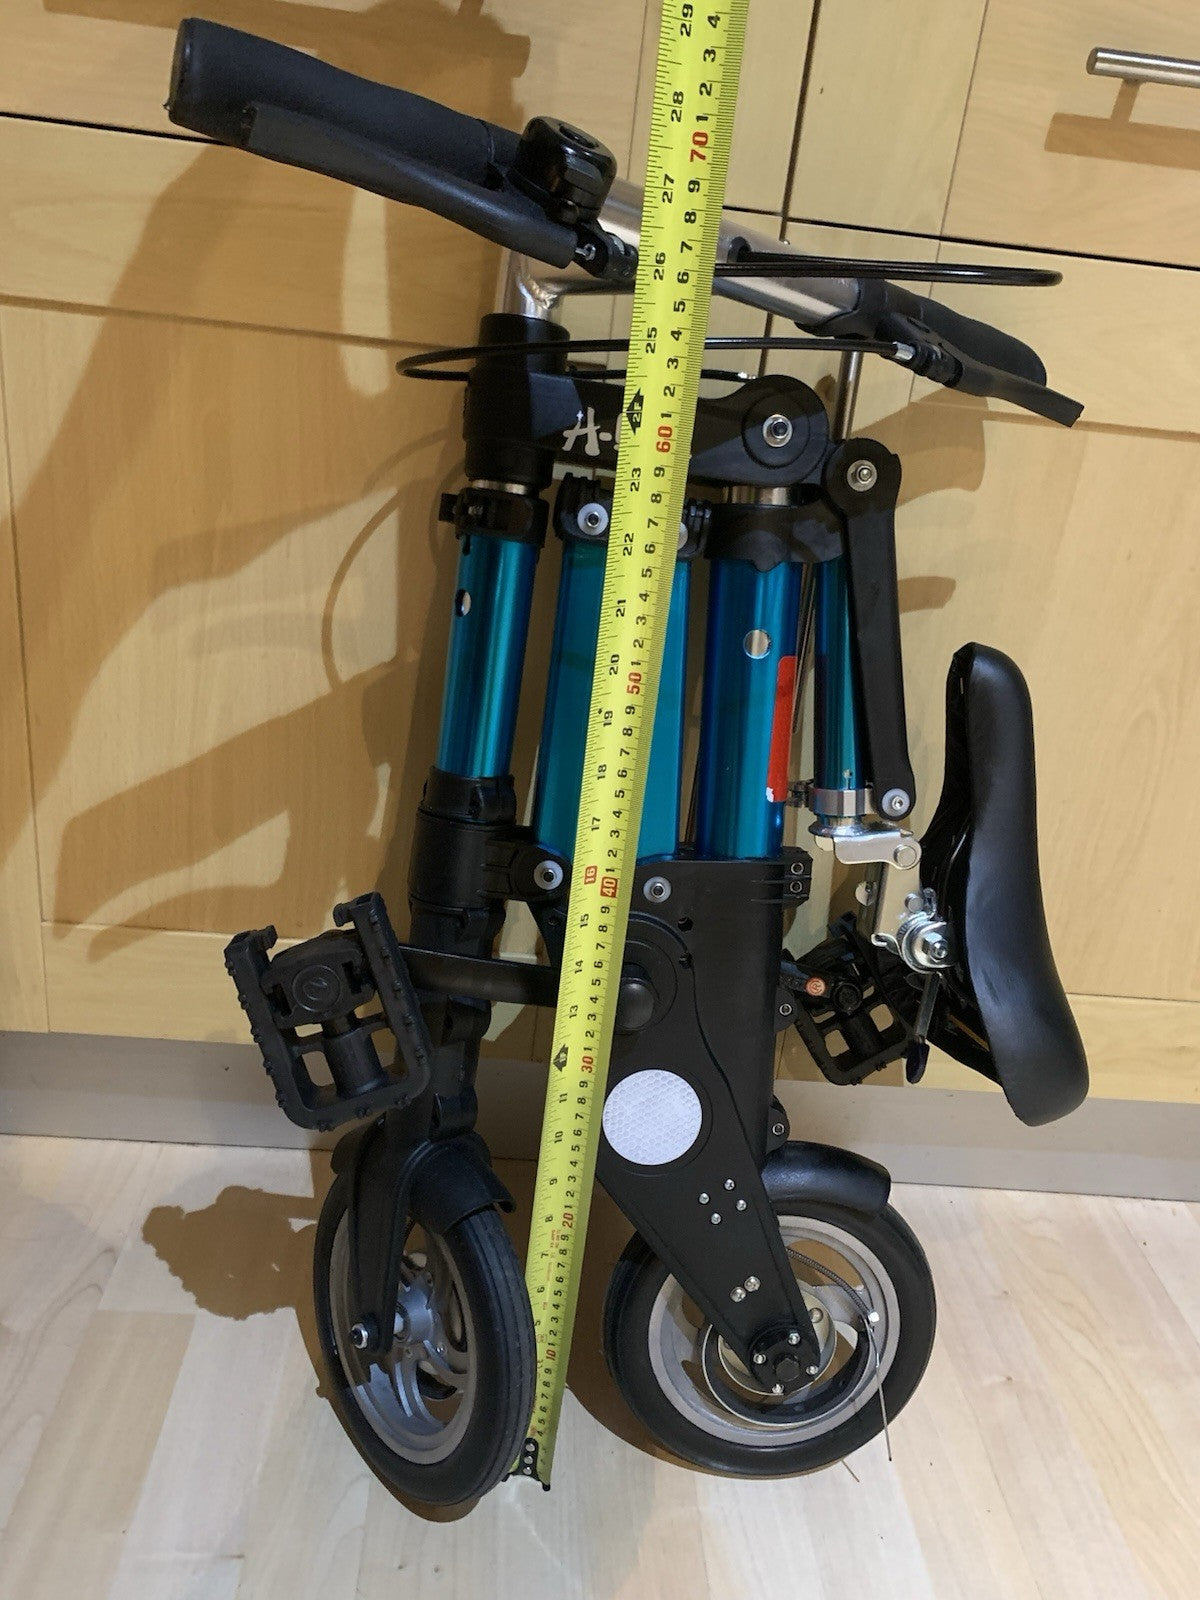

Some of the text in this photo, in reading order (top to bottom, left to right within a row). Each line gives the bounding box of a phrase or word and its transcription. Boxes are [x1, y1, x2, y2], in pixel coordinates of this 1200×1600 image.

[680, 4, 693, 37] 29
[708, 15, 720, 28] 4
[703, 48, 716, 62] 3
[700, 82, 712, 96] 2
[671, 91, 684, 122] 28
[696, 114, 709, 122] 1
[690, 132, 708, 162] 70
[662, 174, 674, 204] 27
[688, 180, 700, 192] 9
[684, 211, 696, 224] 8
[680, 241, 692, 253] 7
[654, 252, 666, 280] 26
[677, 271, 690, 284] 6
[674, 301, 686, 312] 5
[646, 327, 658, 354] 25
[670, 330, 682, 342] 4
[667, 358, 678, 369] 3
[664, 385, 675, 397] 2
[633, 402, 642, 422] 2F
[562, 406, 623, 456] A-
[656, 426, 672, 453] 60
[654, 467, 665, 478] 9
[630, 468, 641, 492] 23
[651, 494, 662, 504] 8
[648, 518, 658, 528] 7
[623, 533, 634, 556] 22
[644, 544, 656, 554] 6
[642, 568, 652, 578] 5
[639, 592, 650, 602] 4
[616, 600, 626, 618] 21
[636, 616, 646, 626] 3
[633, 639, 644, 648] 2
[609, 654, 620, 676] 20
[627, 672, 642, 695] 50
[625, 706, 636, 715] 9
[603, 710, 614, 727] 19
[622, 728, 632, 736] 8
[620, 748, 630, 757] 7
[598, 764, 607, 780] 18
[618, 768, 628, 778] 6
[615, 790, 625, 798] 5
[612, 810, 622, 818] 4
[592, 817, 601, 831] 17
[610, 830, 620, 838] 3
[608, 850, 618, 858] 2
[586, 867, 596, 882] 16
[603, 878, 616, 896] 40
[600, 906, 610, 914] 9
[580, 913, 590, 928] 15
[598, 924, 608, 933] 8
[596, 942, 606, 951] 7
[574, 960, 584, 974] 14
[594, 961, 603, 970] 6
[592, 978, 601, 986] 5
[590, 996, 599, 1004] 4
[570, 1004, 578, 1018] 13
[587, 1013, 596, 1021] 3
[585, 1030, 594, 1038] 2
[581, 1056, 594, 1074] 30
[559, 1093, 568, 1104] 11
[554, 1131, 564, 1144] 10
[562, 1212, 574, 1228] 20
[546, 1349, 556, 1360] 10
